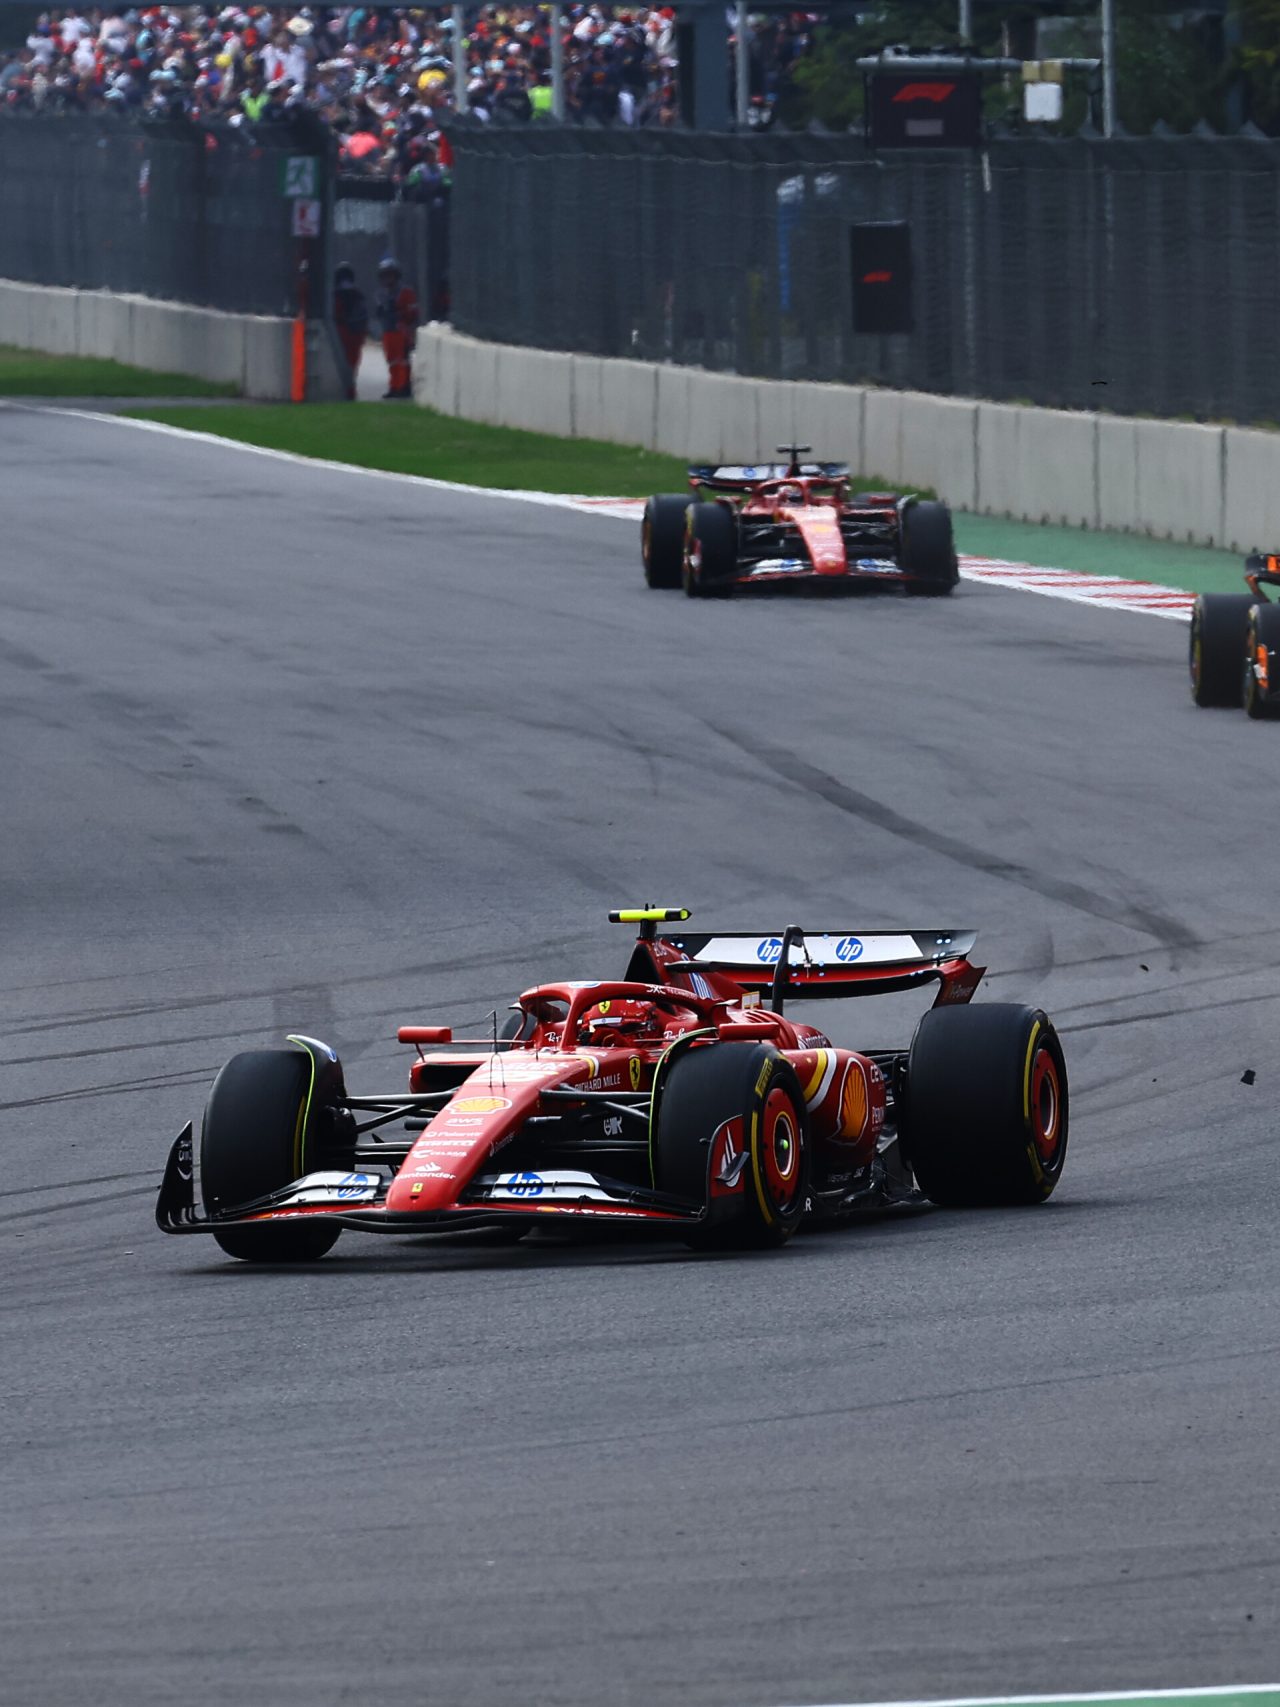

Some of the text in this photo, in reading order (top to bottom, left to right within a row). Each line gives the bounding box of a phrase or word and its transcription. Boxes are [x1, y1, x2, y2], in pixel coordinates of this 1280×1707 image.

[757, 938, 783, 963] hp
[836, 937, 863, 962] hp
[603, 1072, 621, 1087] MILLE
[445, 1117, 484, 1126] aws
[510, 1172, 542, 1196] hp
